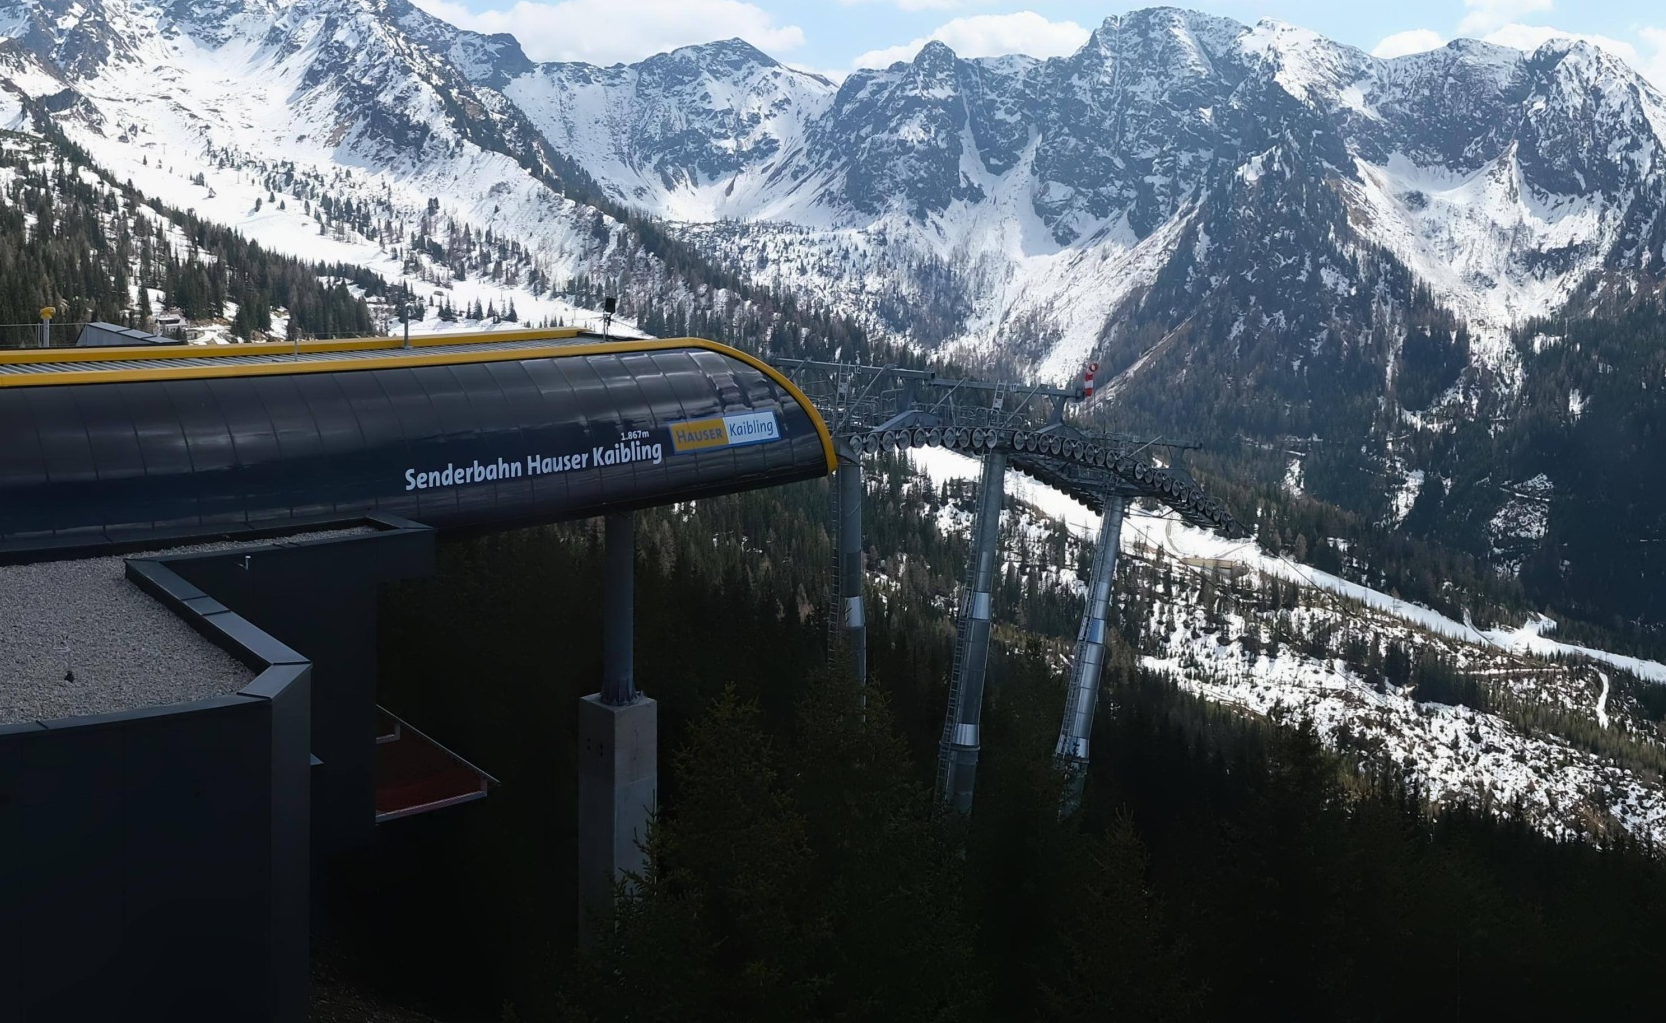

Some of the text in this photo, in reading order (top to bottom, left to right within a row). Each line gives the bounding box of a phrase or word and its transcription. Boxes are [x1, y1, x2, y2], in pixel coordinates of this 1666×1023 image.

[620, 431, 650, 441] 1.867m
[676, 419, 774, 444] HAUSER Kaibling
[405, 441, 662, 491] Senderbahn Hauser Kaibling
